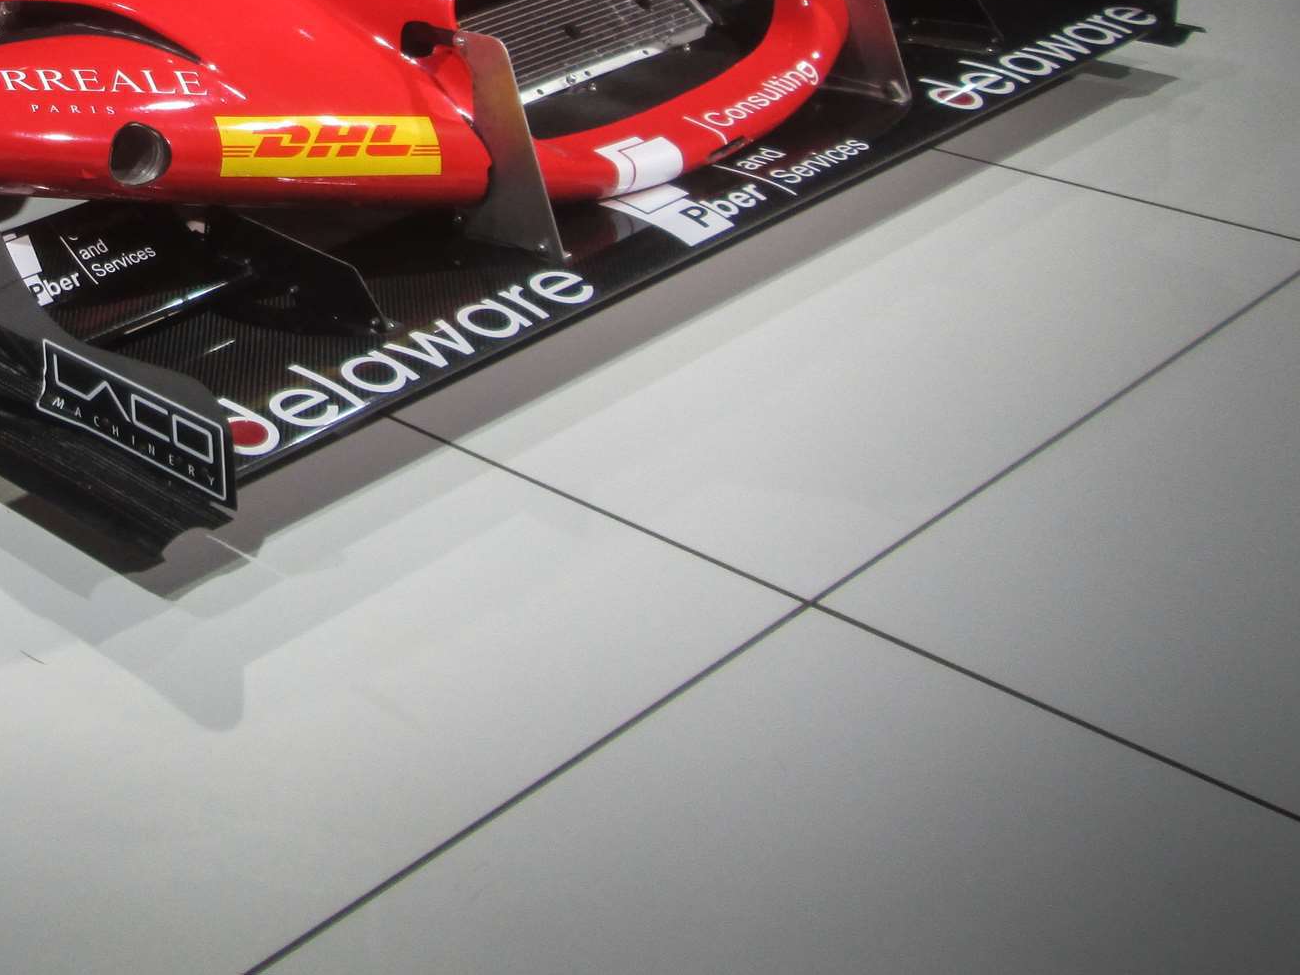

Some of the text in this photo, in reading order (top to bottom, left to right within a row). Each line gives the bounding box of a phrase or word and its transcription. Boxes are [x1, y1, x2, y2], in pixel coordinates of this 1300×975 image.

[918, 6, 1157, 110] delaware
[31, 104, 116, 116] PARIS
[702, 60, 821, 128] Consulting
[251, 124, 413, 159] DHL
[736, 147, 787, 172] and
[769, 137, 870, 185] Services
[79, 239, 109, 261] and
[90, 246, 157, 277] Services
[217, 271, 595, 456] delaware
[52, 353, 214, 465] LACO
[51, 396, 216, 486] MACHINERY
